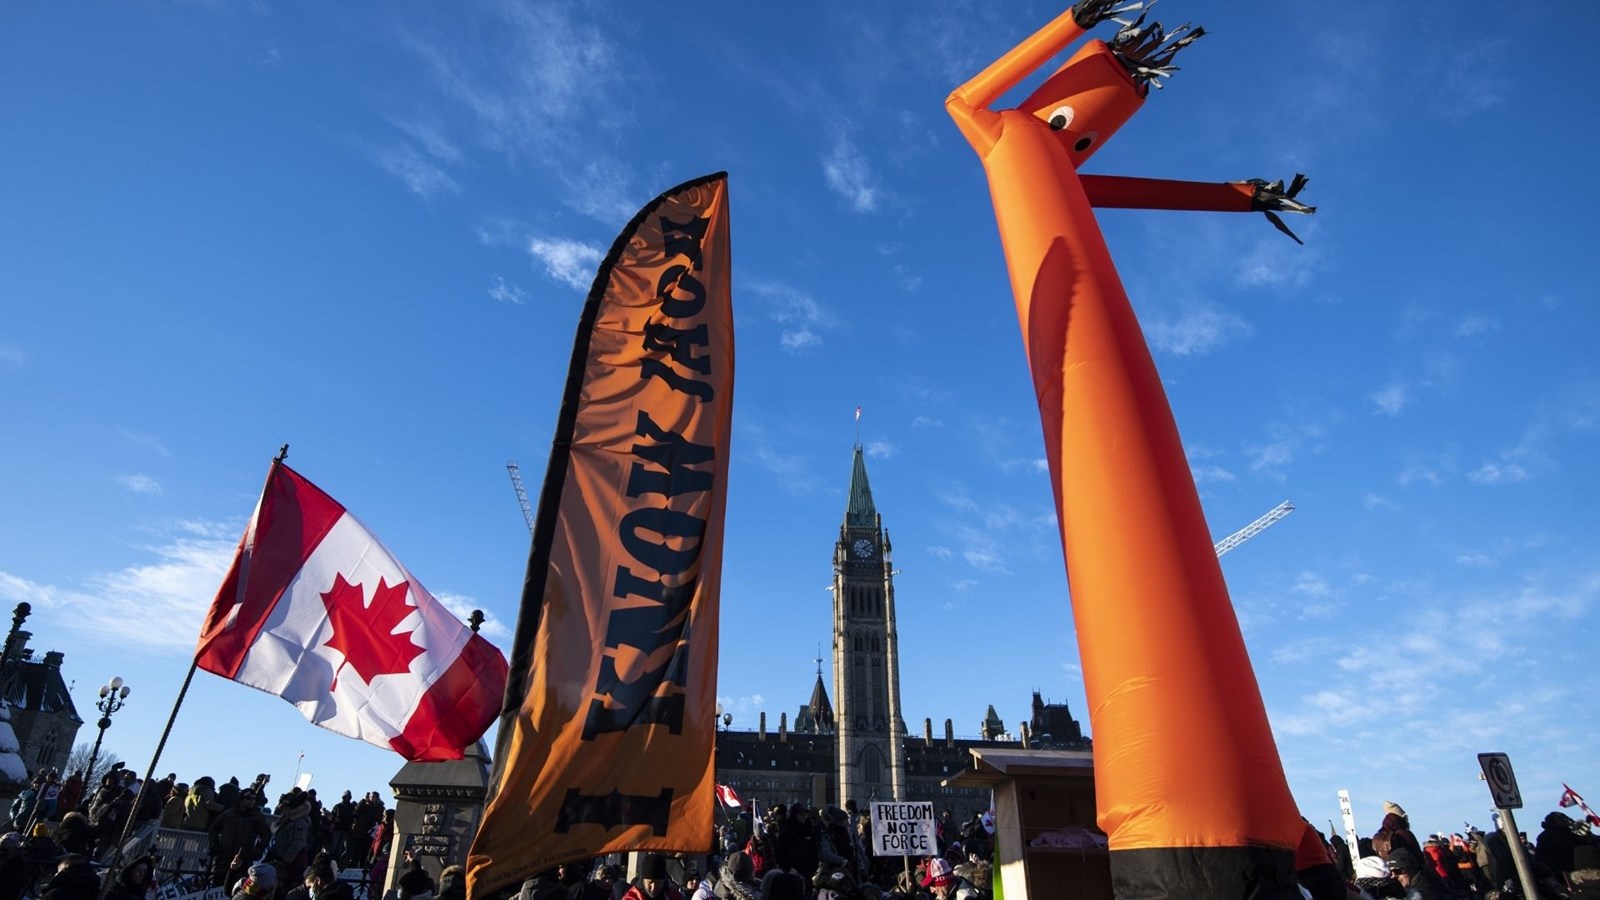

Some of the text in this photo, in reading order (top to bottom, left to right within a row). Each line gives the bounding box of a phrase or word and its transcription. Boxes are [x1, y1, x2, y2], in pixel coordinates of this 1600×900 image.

[584, 411, 716, 741] KNOW
[557, 786, 674, 839] I
[878, 804, 932, 820] FREEDOM
[887, 821, 918, 834] NOT
[882, 834, 928, 851] FORCE
